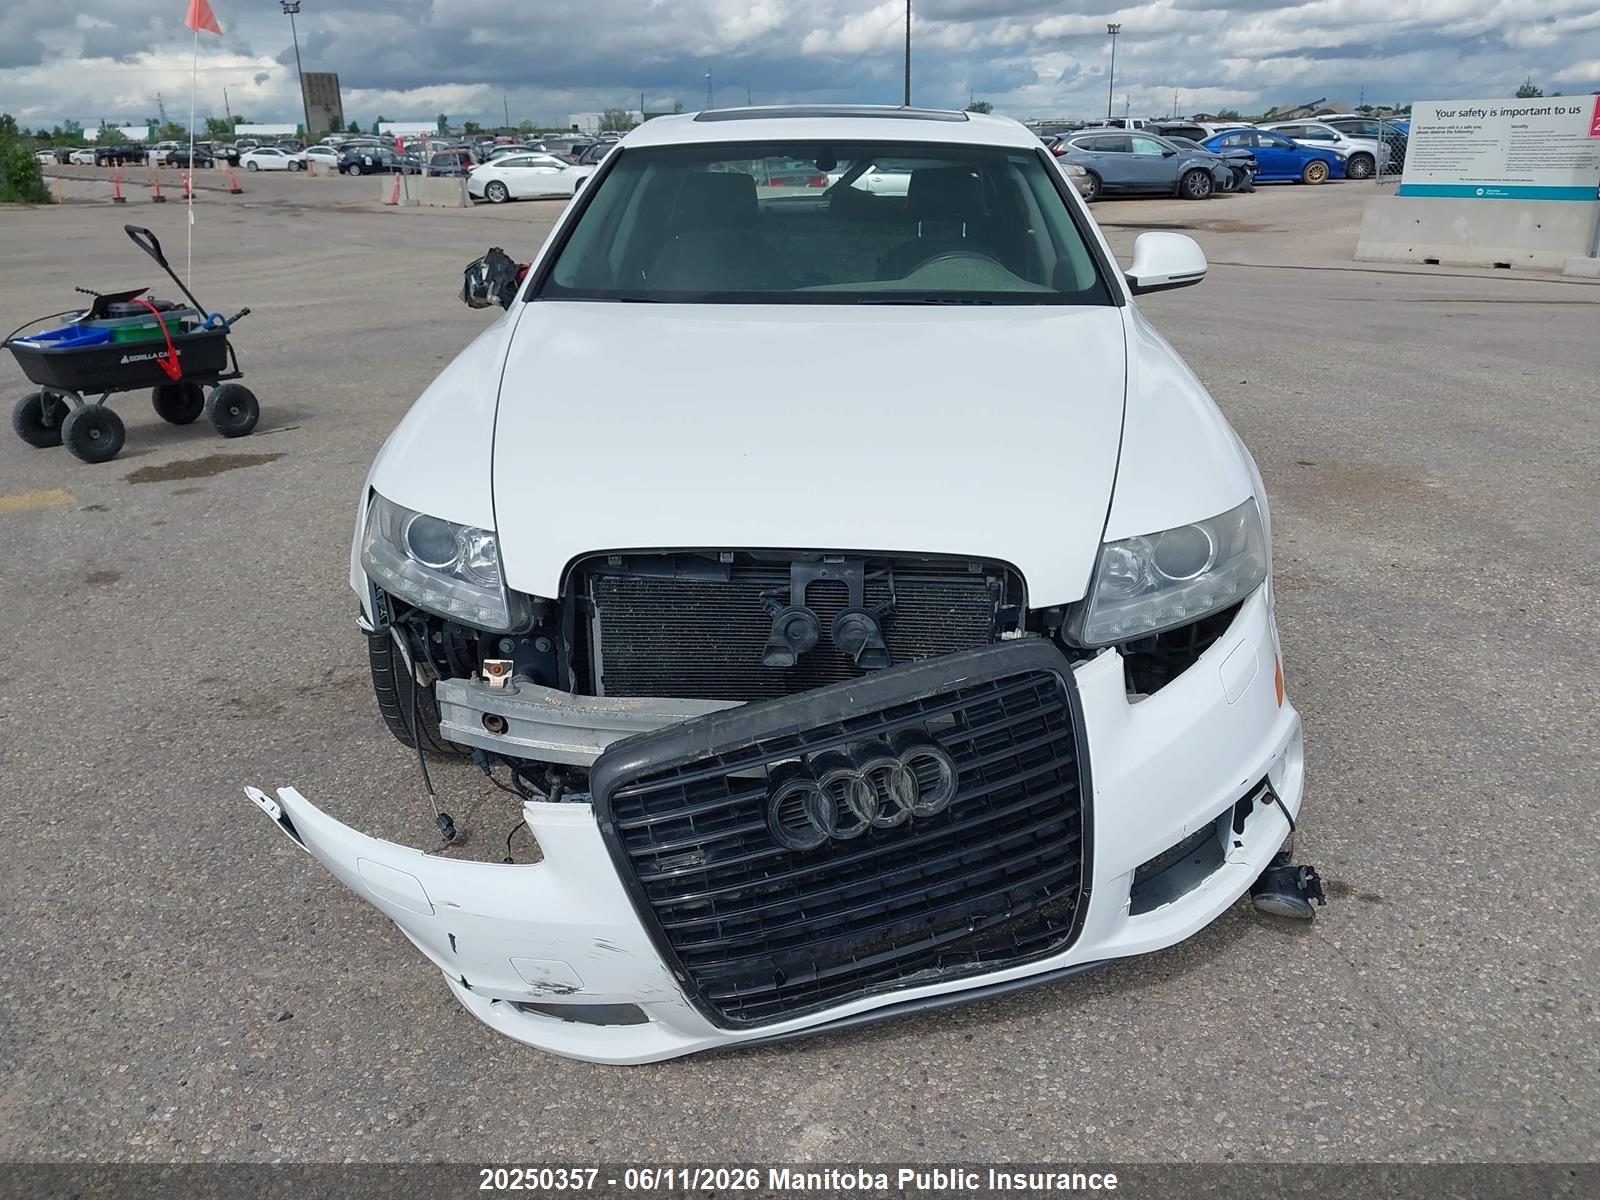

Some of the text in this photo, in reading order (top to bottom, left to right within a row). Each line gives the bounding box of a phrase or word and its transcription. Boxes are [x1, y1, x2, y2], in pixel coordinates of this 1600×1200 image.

[1435, 106, 1582, 119] Your safety is important to us
[129, 353, 158, 362] GORILLA
